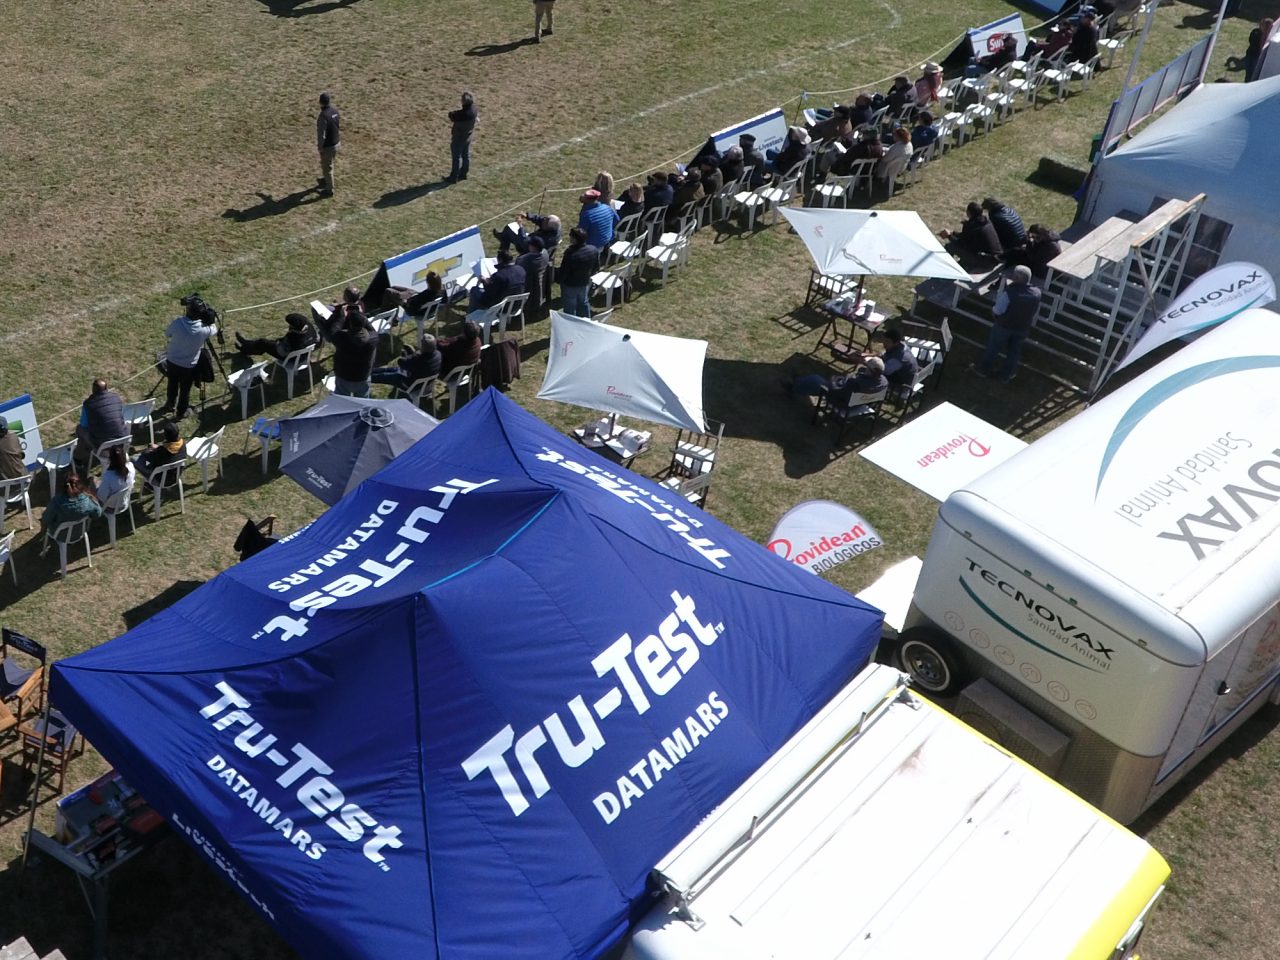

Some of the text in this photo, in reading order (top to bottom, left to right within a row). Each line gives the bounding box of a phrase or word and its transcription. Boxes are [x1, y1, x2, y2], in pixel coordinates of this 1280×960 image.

[1159, 270, 1263, 324] TECNOVAX
[916, 430, 992, 468] Providean
[1113, 431, 1253, 528] Sanidad Animal
[261, 478, 500, 642] Tru-Test
[268, 499, 399, 593] DATAMARS
[535, 449, 732, 570] Tru-Test
[767, 523, 867, 566] Povidean
[811, 536, 881, 574] BIOLÓGICOS
[965, 556, 1116, 661] TECNOVAX
[1026, 612, 1111, 672] Sanidad Animal
[461, 590, 718, 817] Tru-Test
[199, 681, 403, 863] Tru-Test
[207, 754, 327, 860] DATAMARS
[592, 691, 729, 825] DATAMARS
